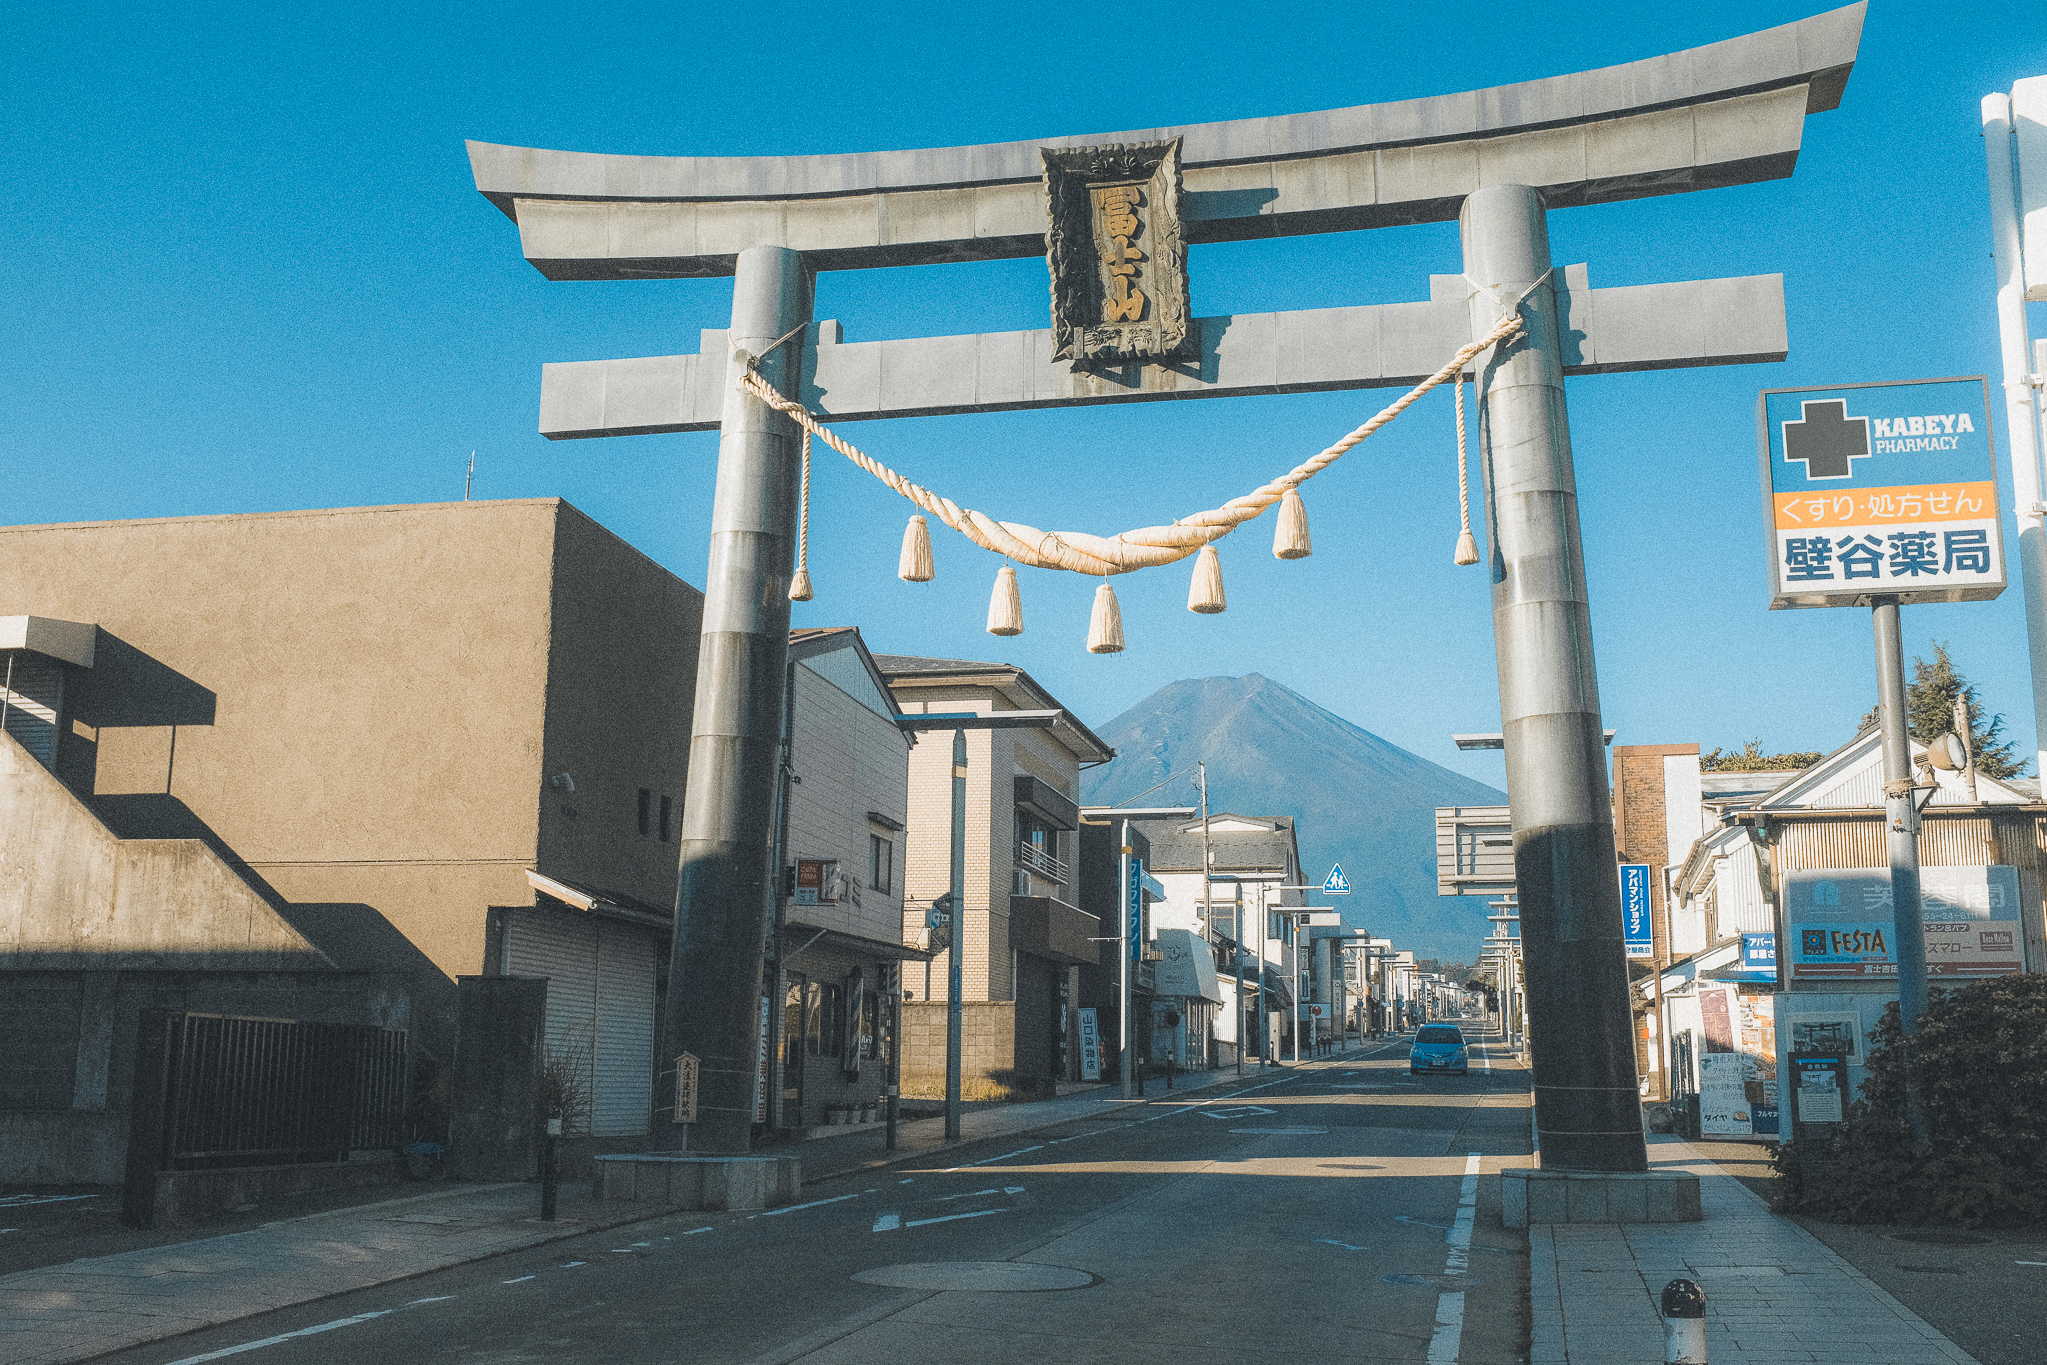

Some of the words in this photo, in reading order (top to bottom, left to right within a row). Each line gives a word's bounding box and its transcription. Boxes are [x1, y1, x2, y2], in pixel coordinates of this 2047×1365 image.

[1099, 185, 1145, 322] 富士山
[1873, 412, 1976, 438] KABEYA
[1875, 435, 1960, 454] PHARMACY
[1785, 529, 1991, 582] 壁谷薬局
[1628, 868, 1641, 935] アパマンショップ
[1924, 911, 1978, 921] 55-24-8111
[1923, 924, 1968, 932] トラン&パブ
[1831, 929, 1887, 955] FESTA
[1924, 942, 1973, 953] ズマロー
[1749, 949, 1775, 960] 部屋さ
[1082, 1014, 1096, 1070] 山口染物店
[1703, 1113, 1728, 1122] タイヤ
[1757, 1110, 1779, 1118] フルヤタ
